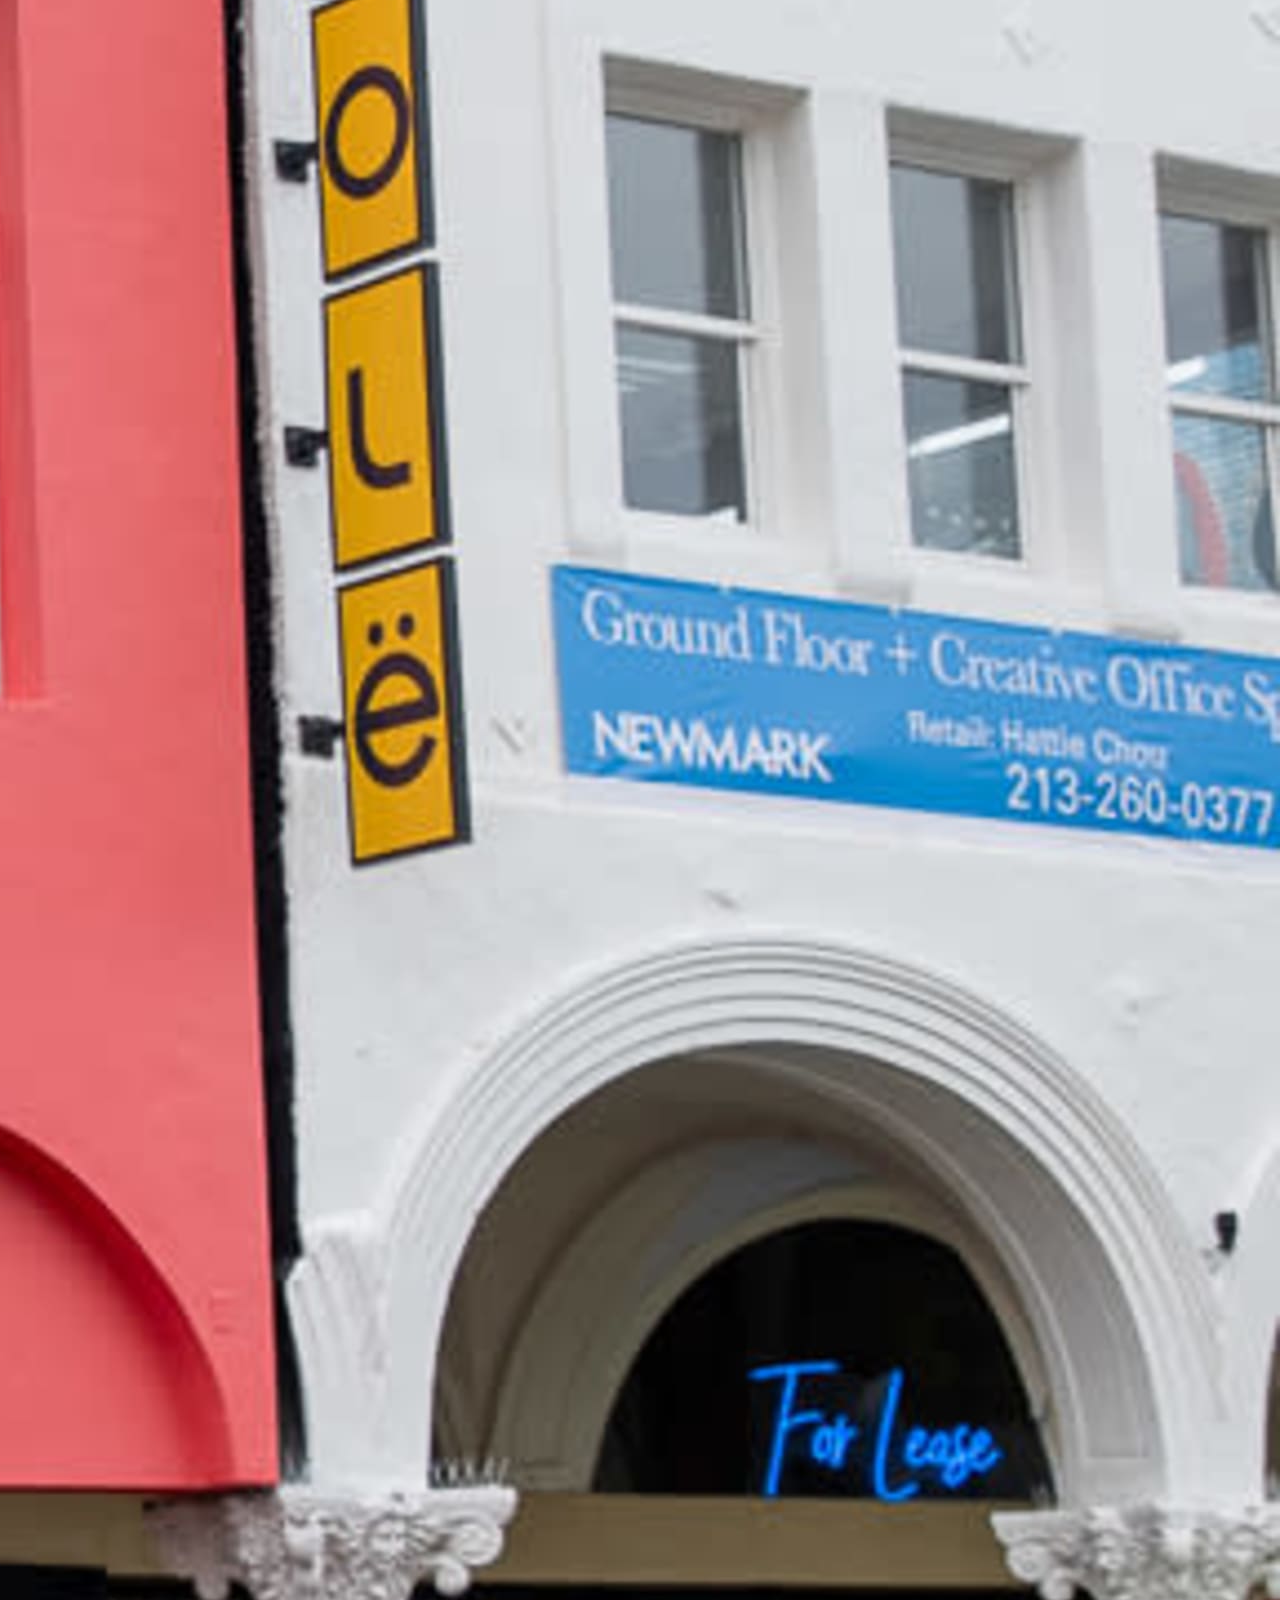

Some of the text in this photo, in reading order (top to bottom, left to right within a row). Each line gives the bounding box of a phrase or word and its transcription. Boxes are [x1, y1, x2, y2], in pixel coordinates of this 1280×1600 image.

[581, 587, 754, 663] Ground
[763, 606, 874, 677] Floor
[885, 632, 918, 676] +
[929, 632, 1098, 704] Creative
[1106, 654, 1237, 719] Office
[592, 709, 835, 784] NEWMARK
[1000, 716, 1086, 761] Hattie
[1003, 760, 1274, 837] 213-260-0377
[745, 1358, 1003, 1504] For Lease
